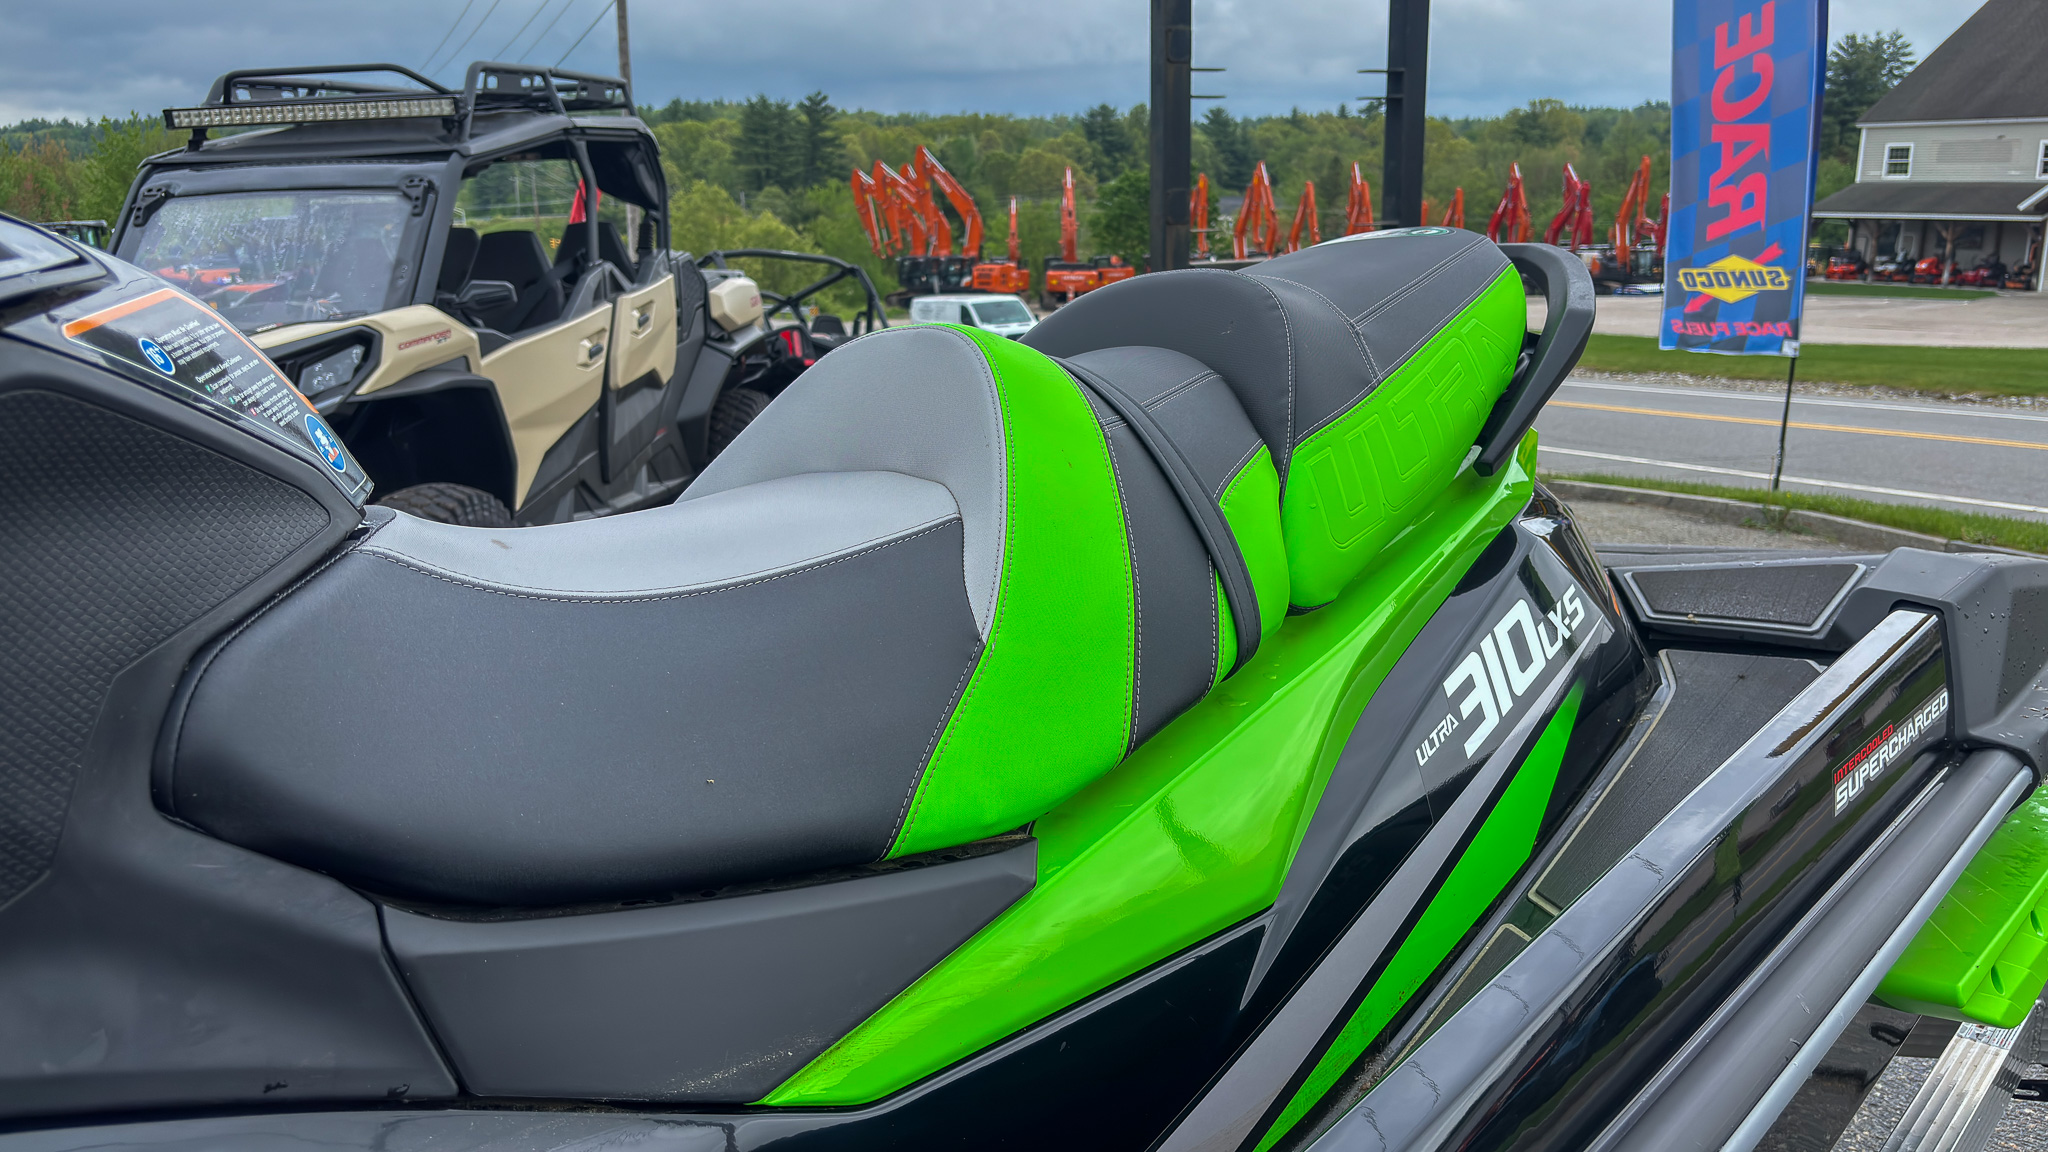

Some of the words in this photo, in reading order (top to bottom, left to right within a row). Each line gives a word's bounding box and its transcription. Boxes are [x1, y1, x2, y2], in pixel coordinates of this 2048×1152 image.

[1415, 713, 1459, 767] ULTRA
[1442, 598, 1547, 760] 310
[1834, 724, 1894, 785] INTERCOOLED
[1835, 690, 1949, 815] SUPERCHARGED
